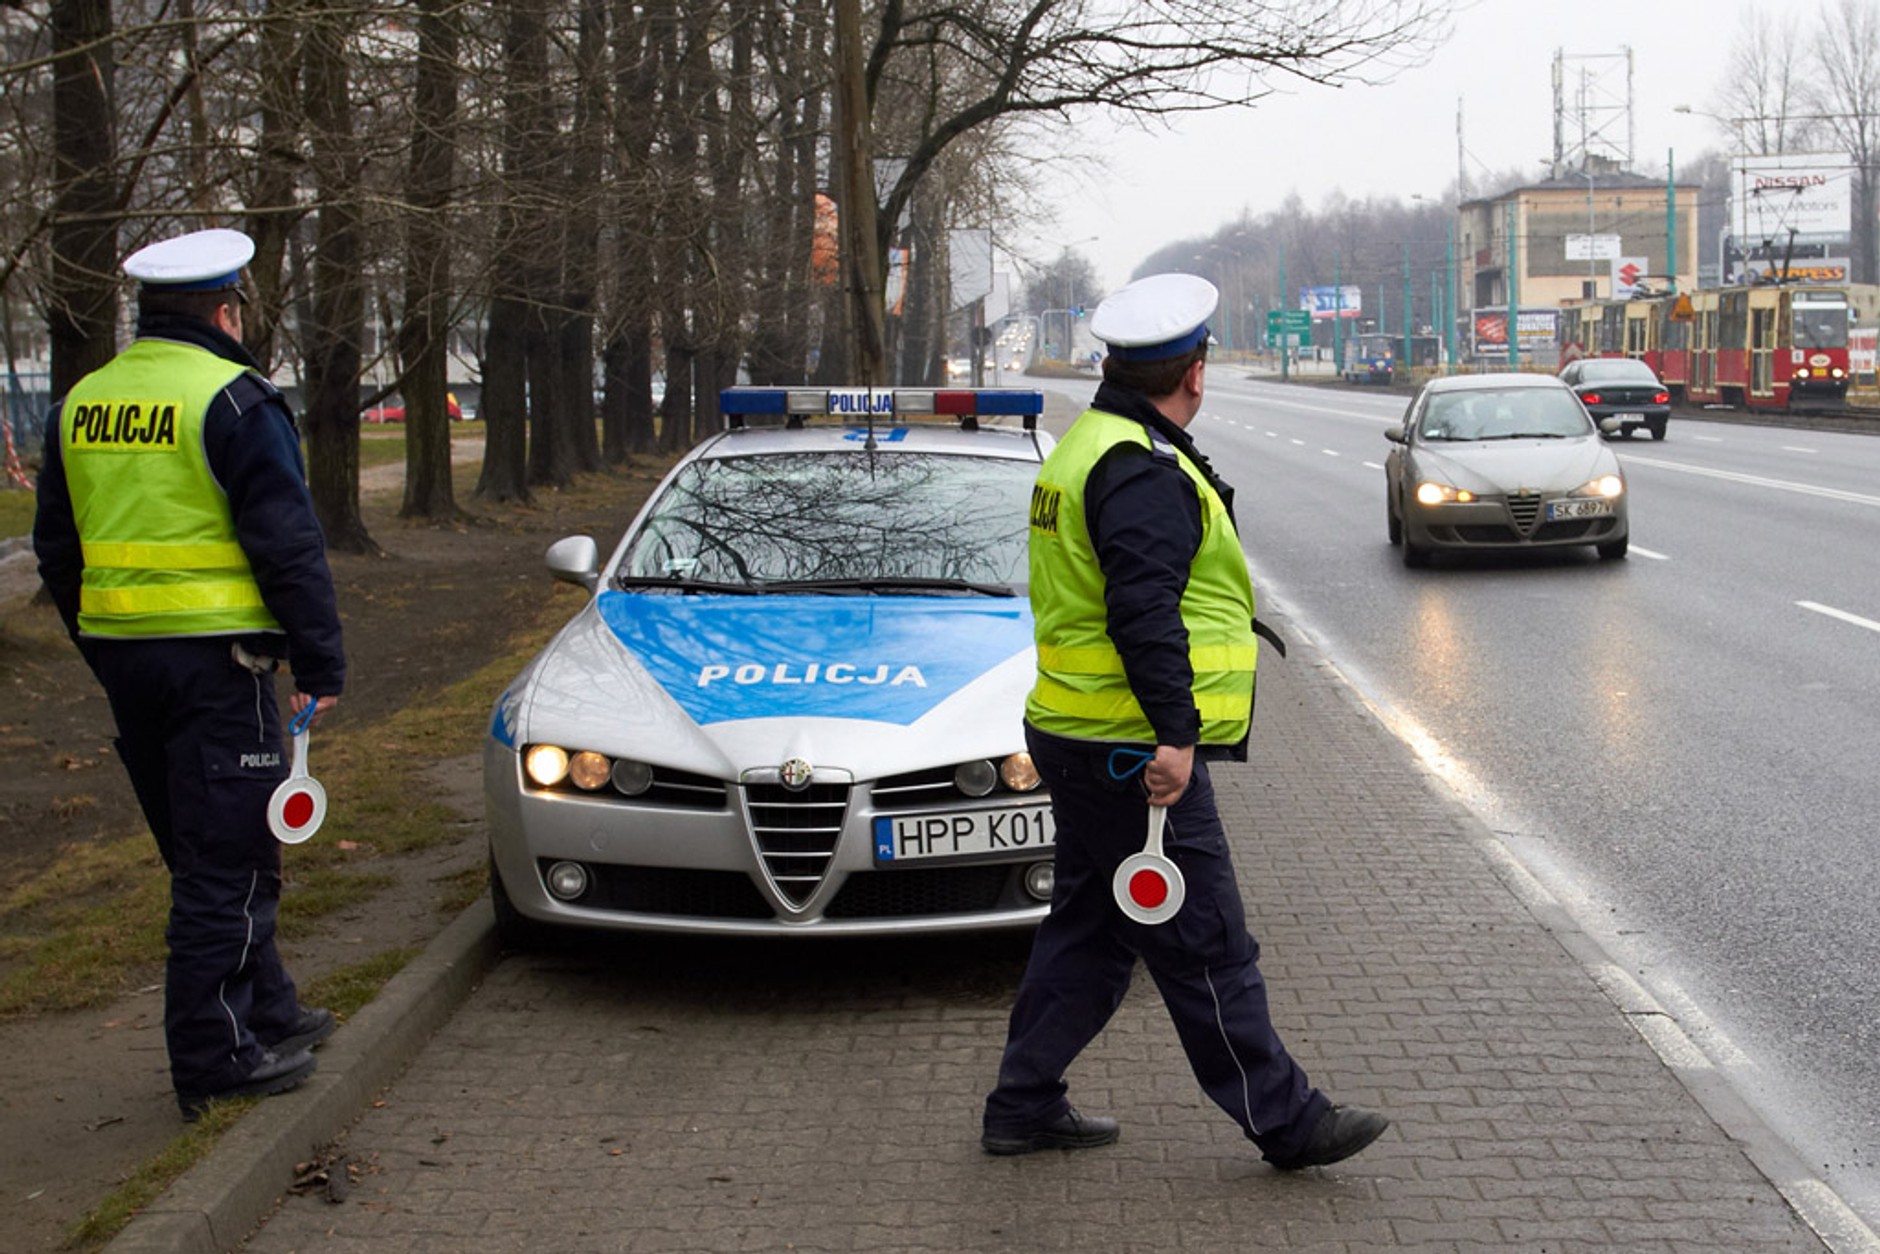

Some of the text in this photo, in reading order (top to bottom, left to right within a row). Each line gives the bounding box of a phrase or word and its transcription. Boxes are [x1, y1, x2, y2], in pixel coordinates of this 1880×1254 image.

[1755, 175, 1826, 189] NISSAN
[830, 394, 893, 412] POLICJA
[71, 404, 176, 445] POLICJA
[1555, 504, 1573, 517] SK
[698, 663, 928, 688] POLICJA
[240, 752, 280, 768] POLICJA
[879, 844, 892, 855] PL
[899, 816, 975, 856] HPP
